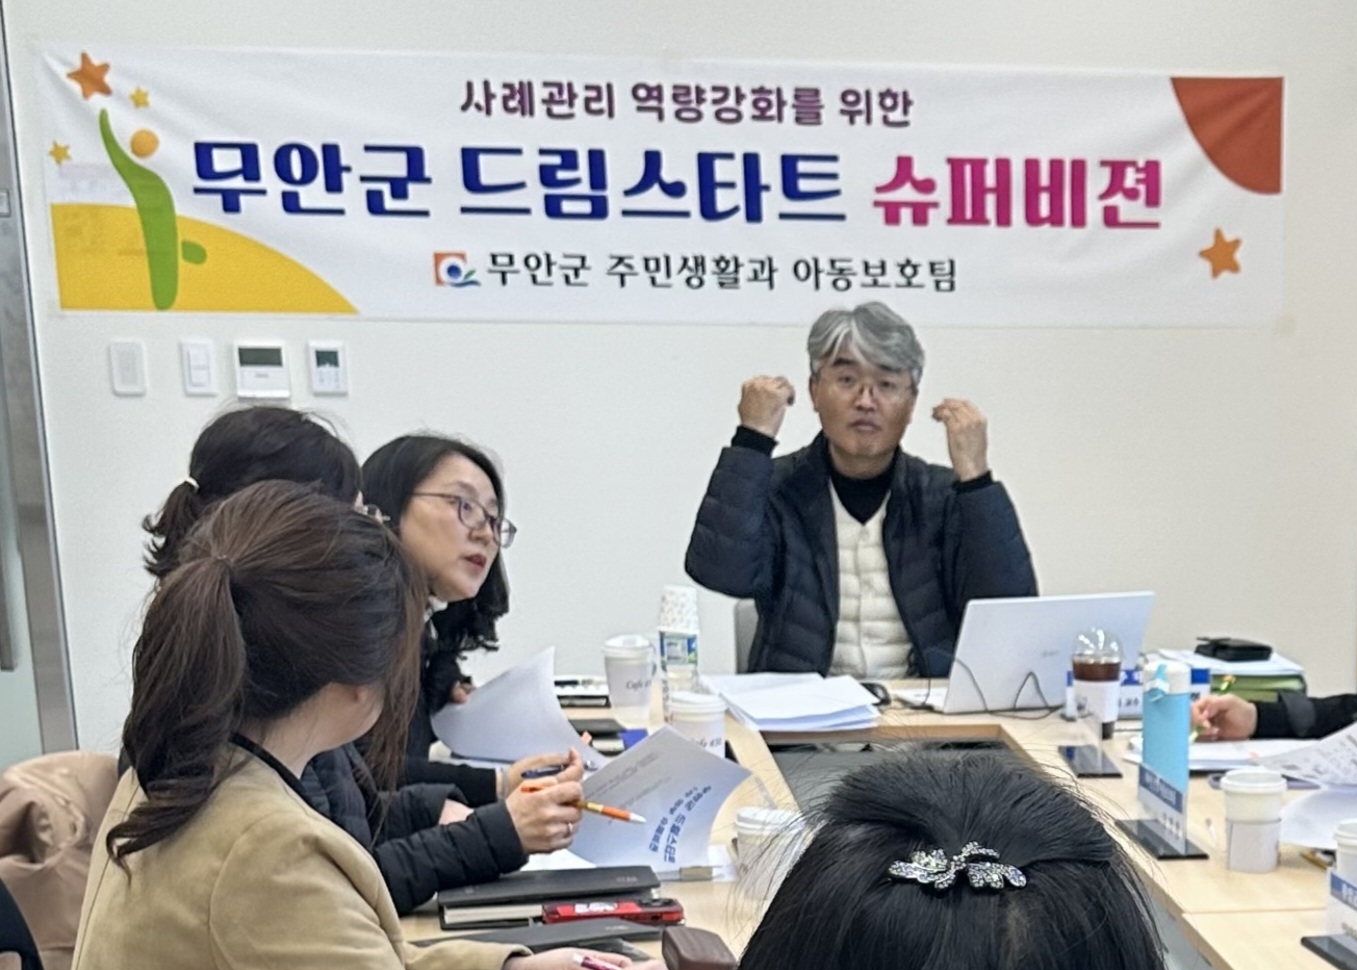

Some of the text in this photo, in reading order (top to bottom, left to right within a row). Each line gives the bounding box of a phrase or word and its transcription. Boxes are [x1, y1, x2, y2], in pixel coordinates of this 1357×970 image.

[461, 80, 914, 128] 사례관리 역량강화를 위한
[192, 141, 1162, 230] 무안군 드림스타트 슈퍼비젼
[488, 252, 957, 292] 무안군 주민생활과 아동보호팀
